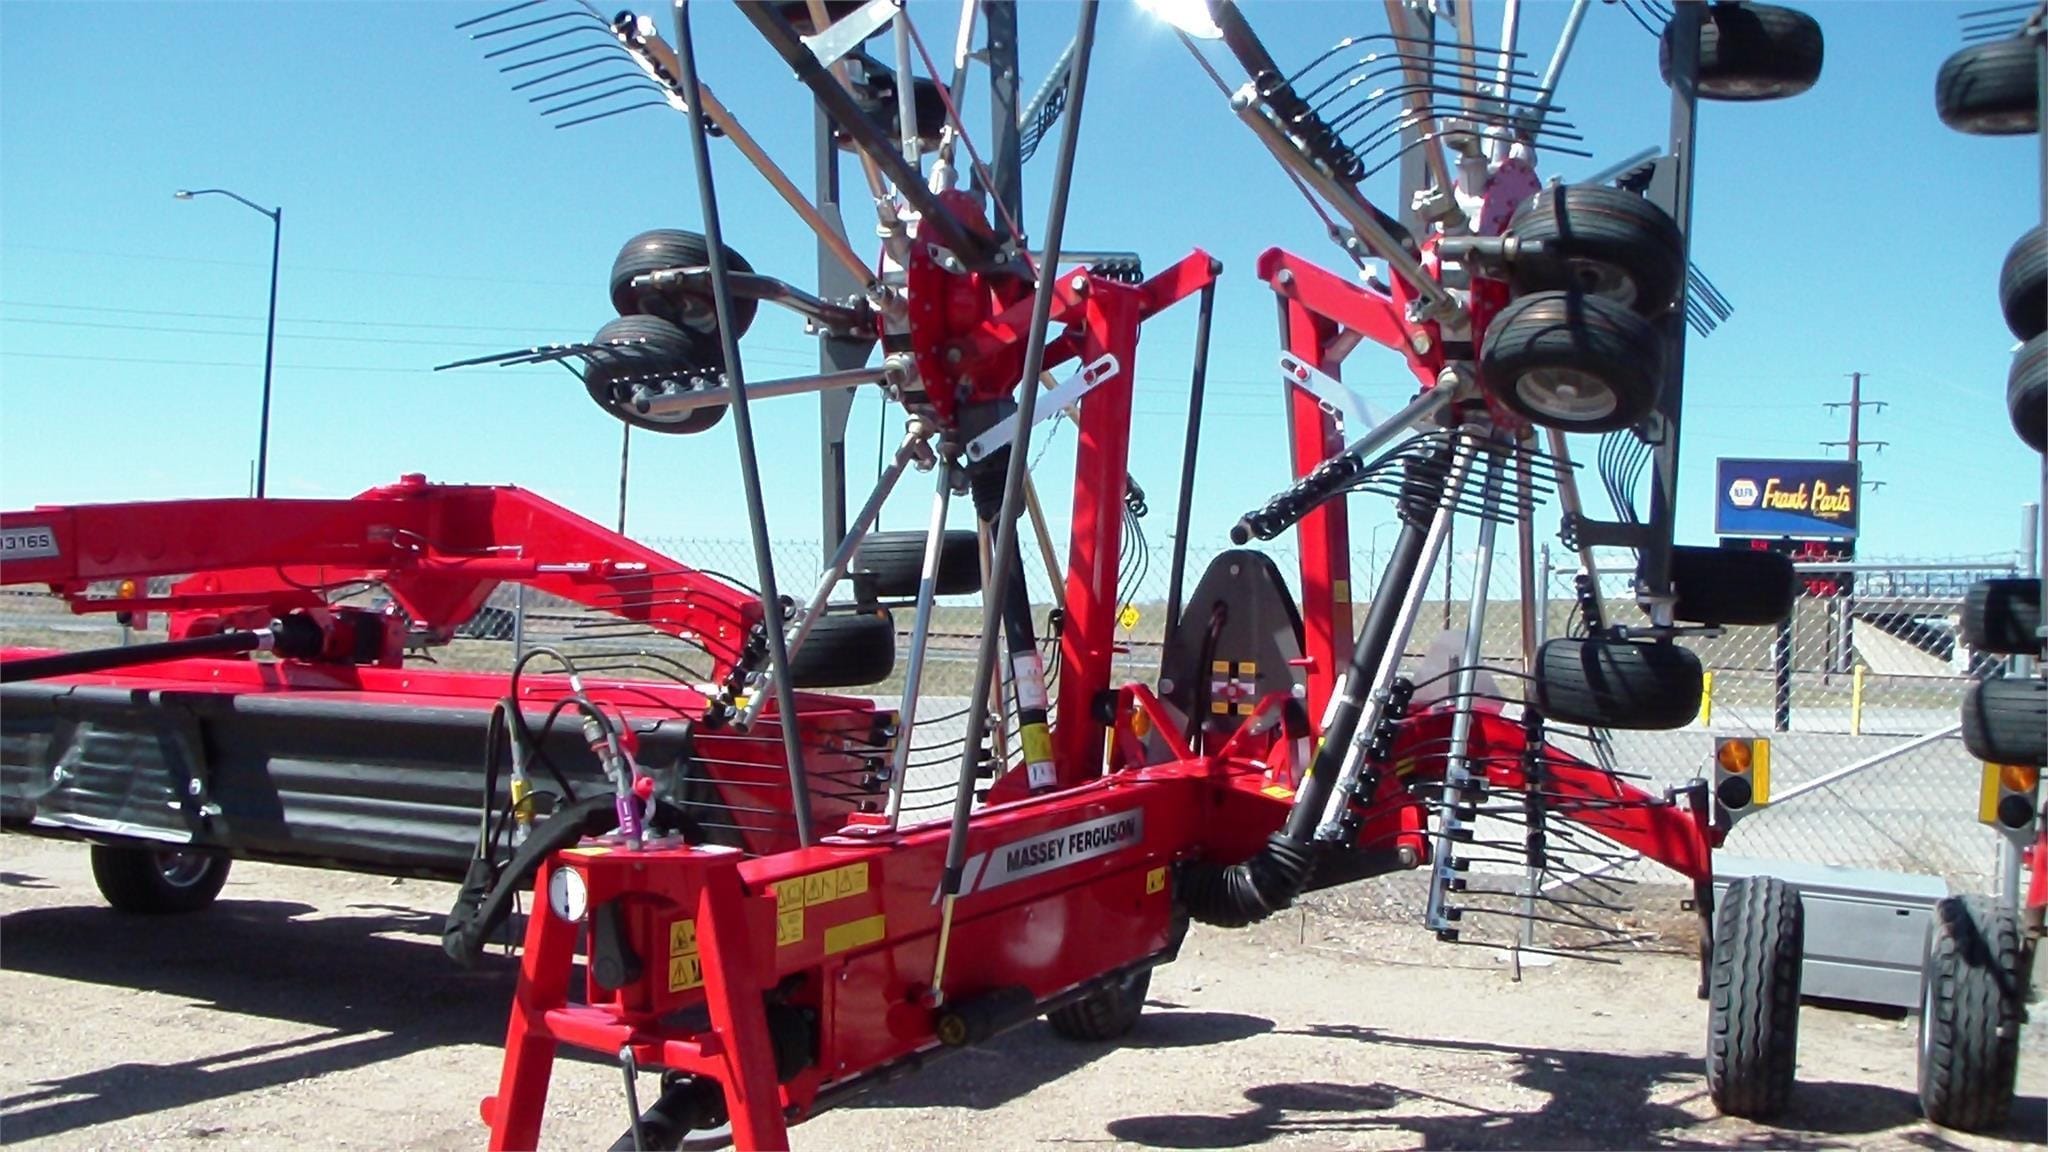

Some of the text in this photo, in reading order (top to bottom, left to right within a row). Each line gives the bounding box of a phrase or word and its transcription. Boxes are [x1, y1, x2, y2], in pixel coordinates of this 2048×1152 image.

[1761, 478, 1851, 512] Frank Parts
[1006, 817, 1136, 873] MASSEY FERGUSON
